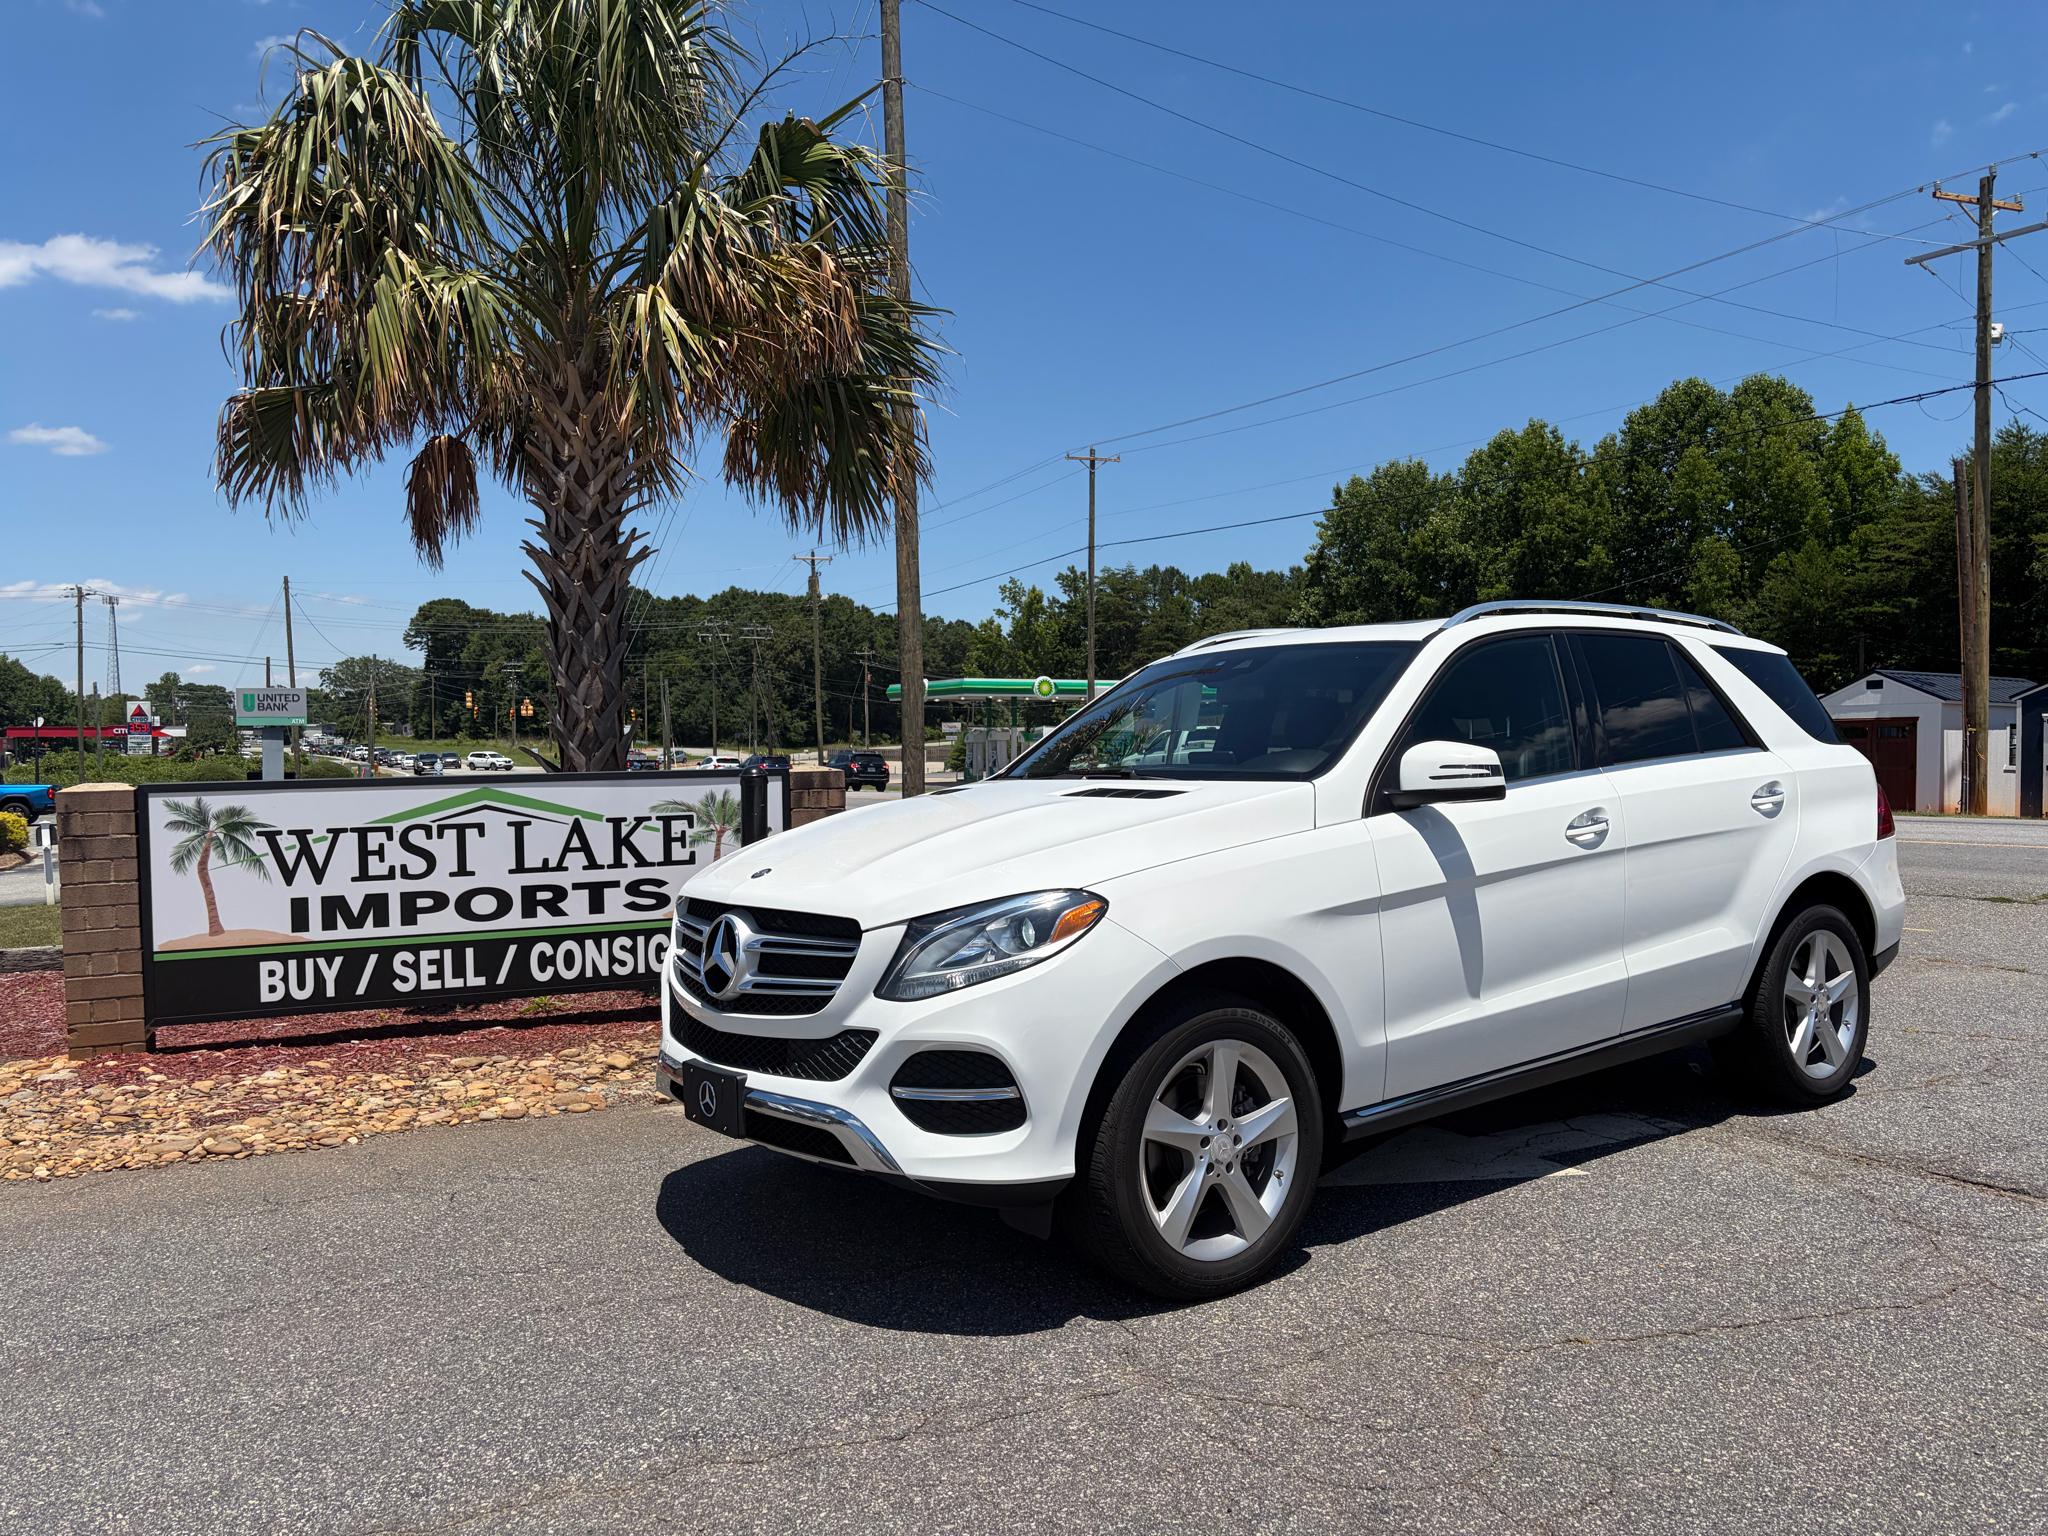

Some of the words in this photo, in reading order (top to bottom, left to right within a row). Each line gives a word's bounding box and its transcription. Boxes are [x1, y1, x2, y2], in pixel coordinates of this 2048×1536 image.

[257, 693, 300, 703] UNITED
[257, 702, 289, 712] BANK
[256, 822, 486, 887] WEST
[507, 814, 697, 875] LAKE
[290, 877, 672, 934] IMPORTS
[259, 955, 344, 1003] BUY
[355, 953, 379, 996] /
[392, 946, 487, 993] SELL
[495, 944, 518, 985] /
